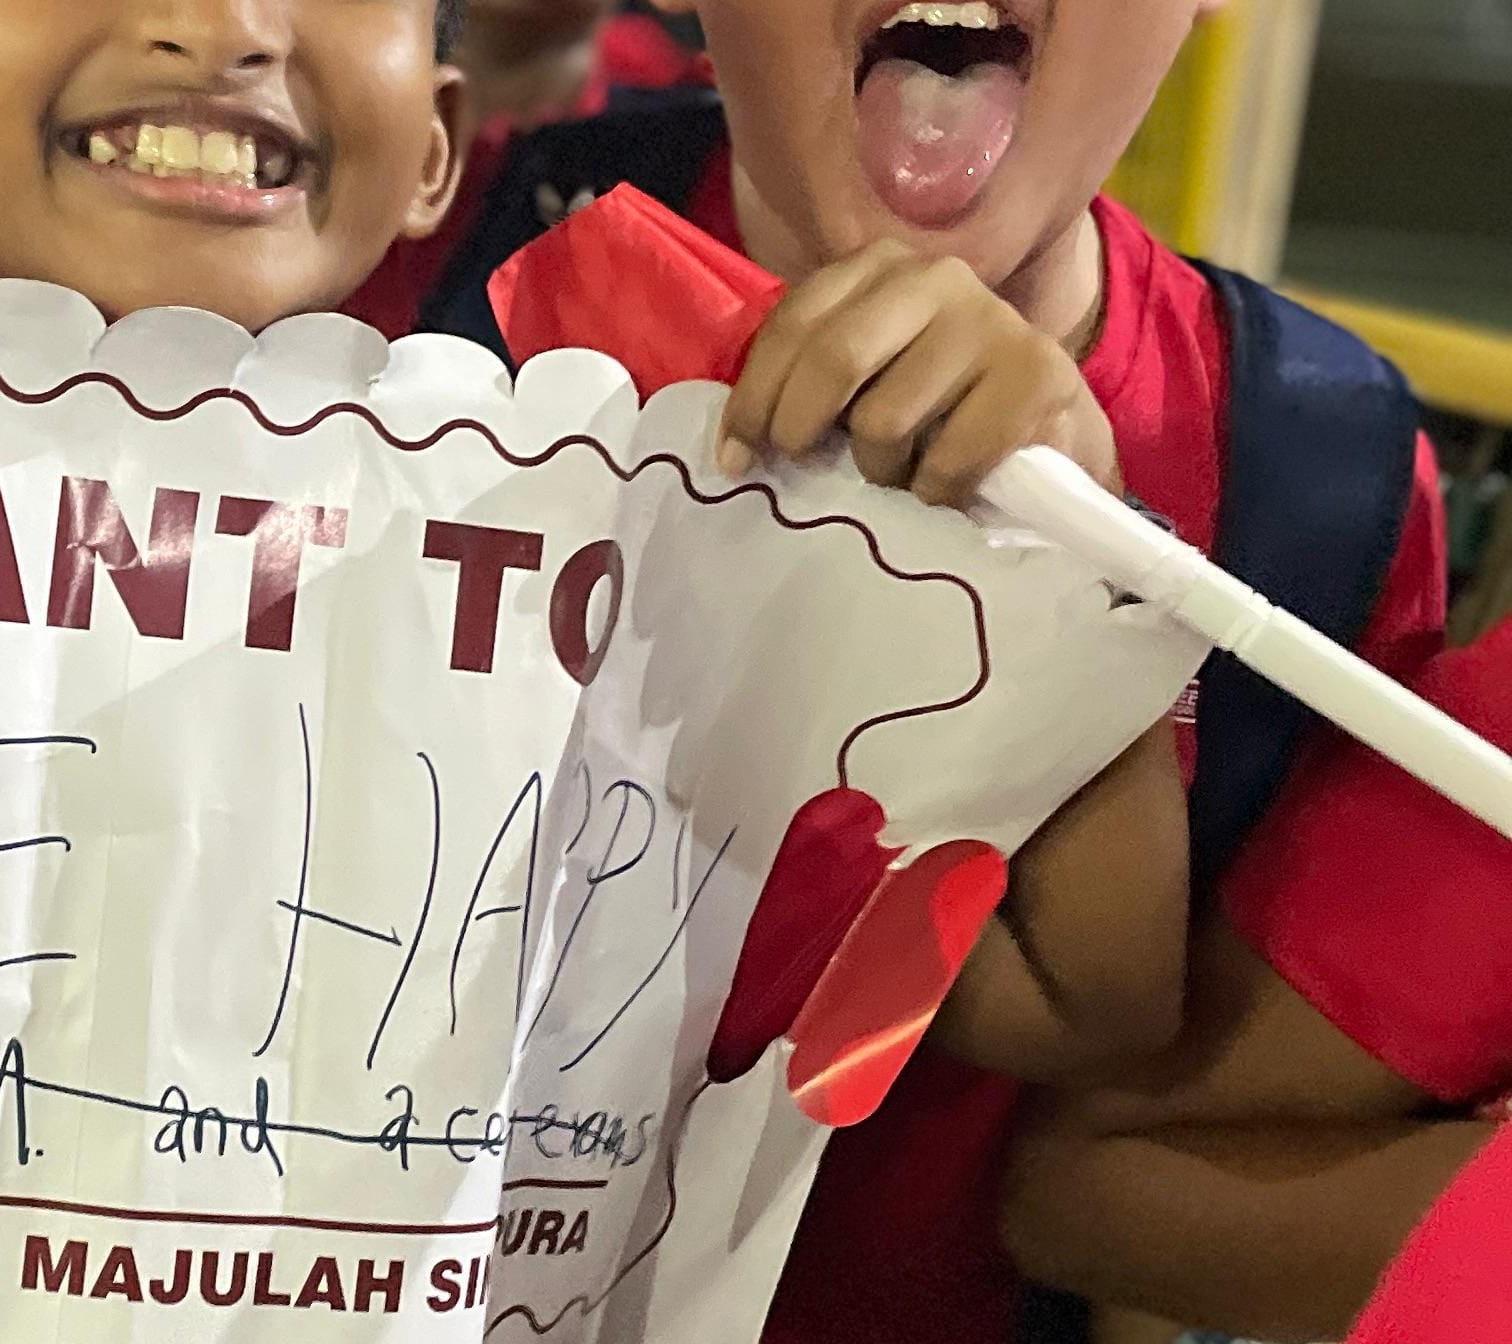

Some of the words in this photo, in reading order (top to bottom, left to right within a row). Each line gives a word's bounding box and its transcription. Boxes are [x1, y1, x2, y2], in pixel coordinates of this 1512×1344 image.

[422, 520, 625, 686] TO
[155, 1077, 284, 1177] and
[21, 1235, 405, 1314] MAJULAH
